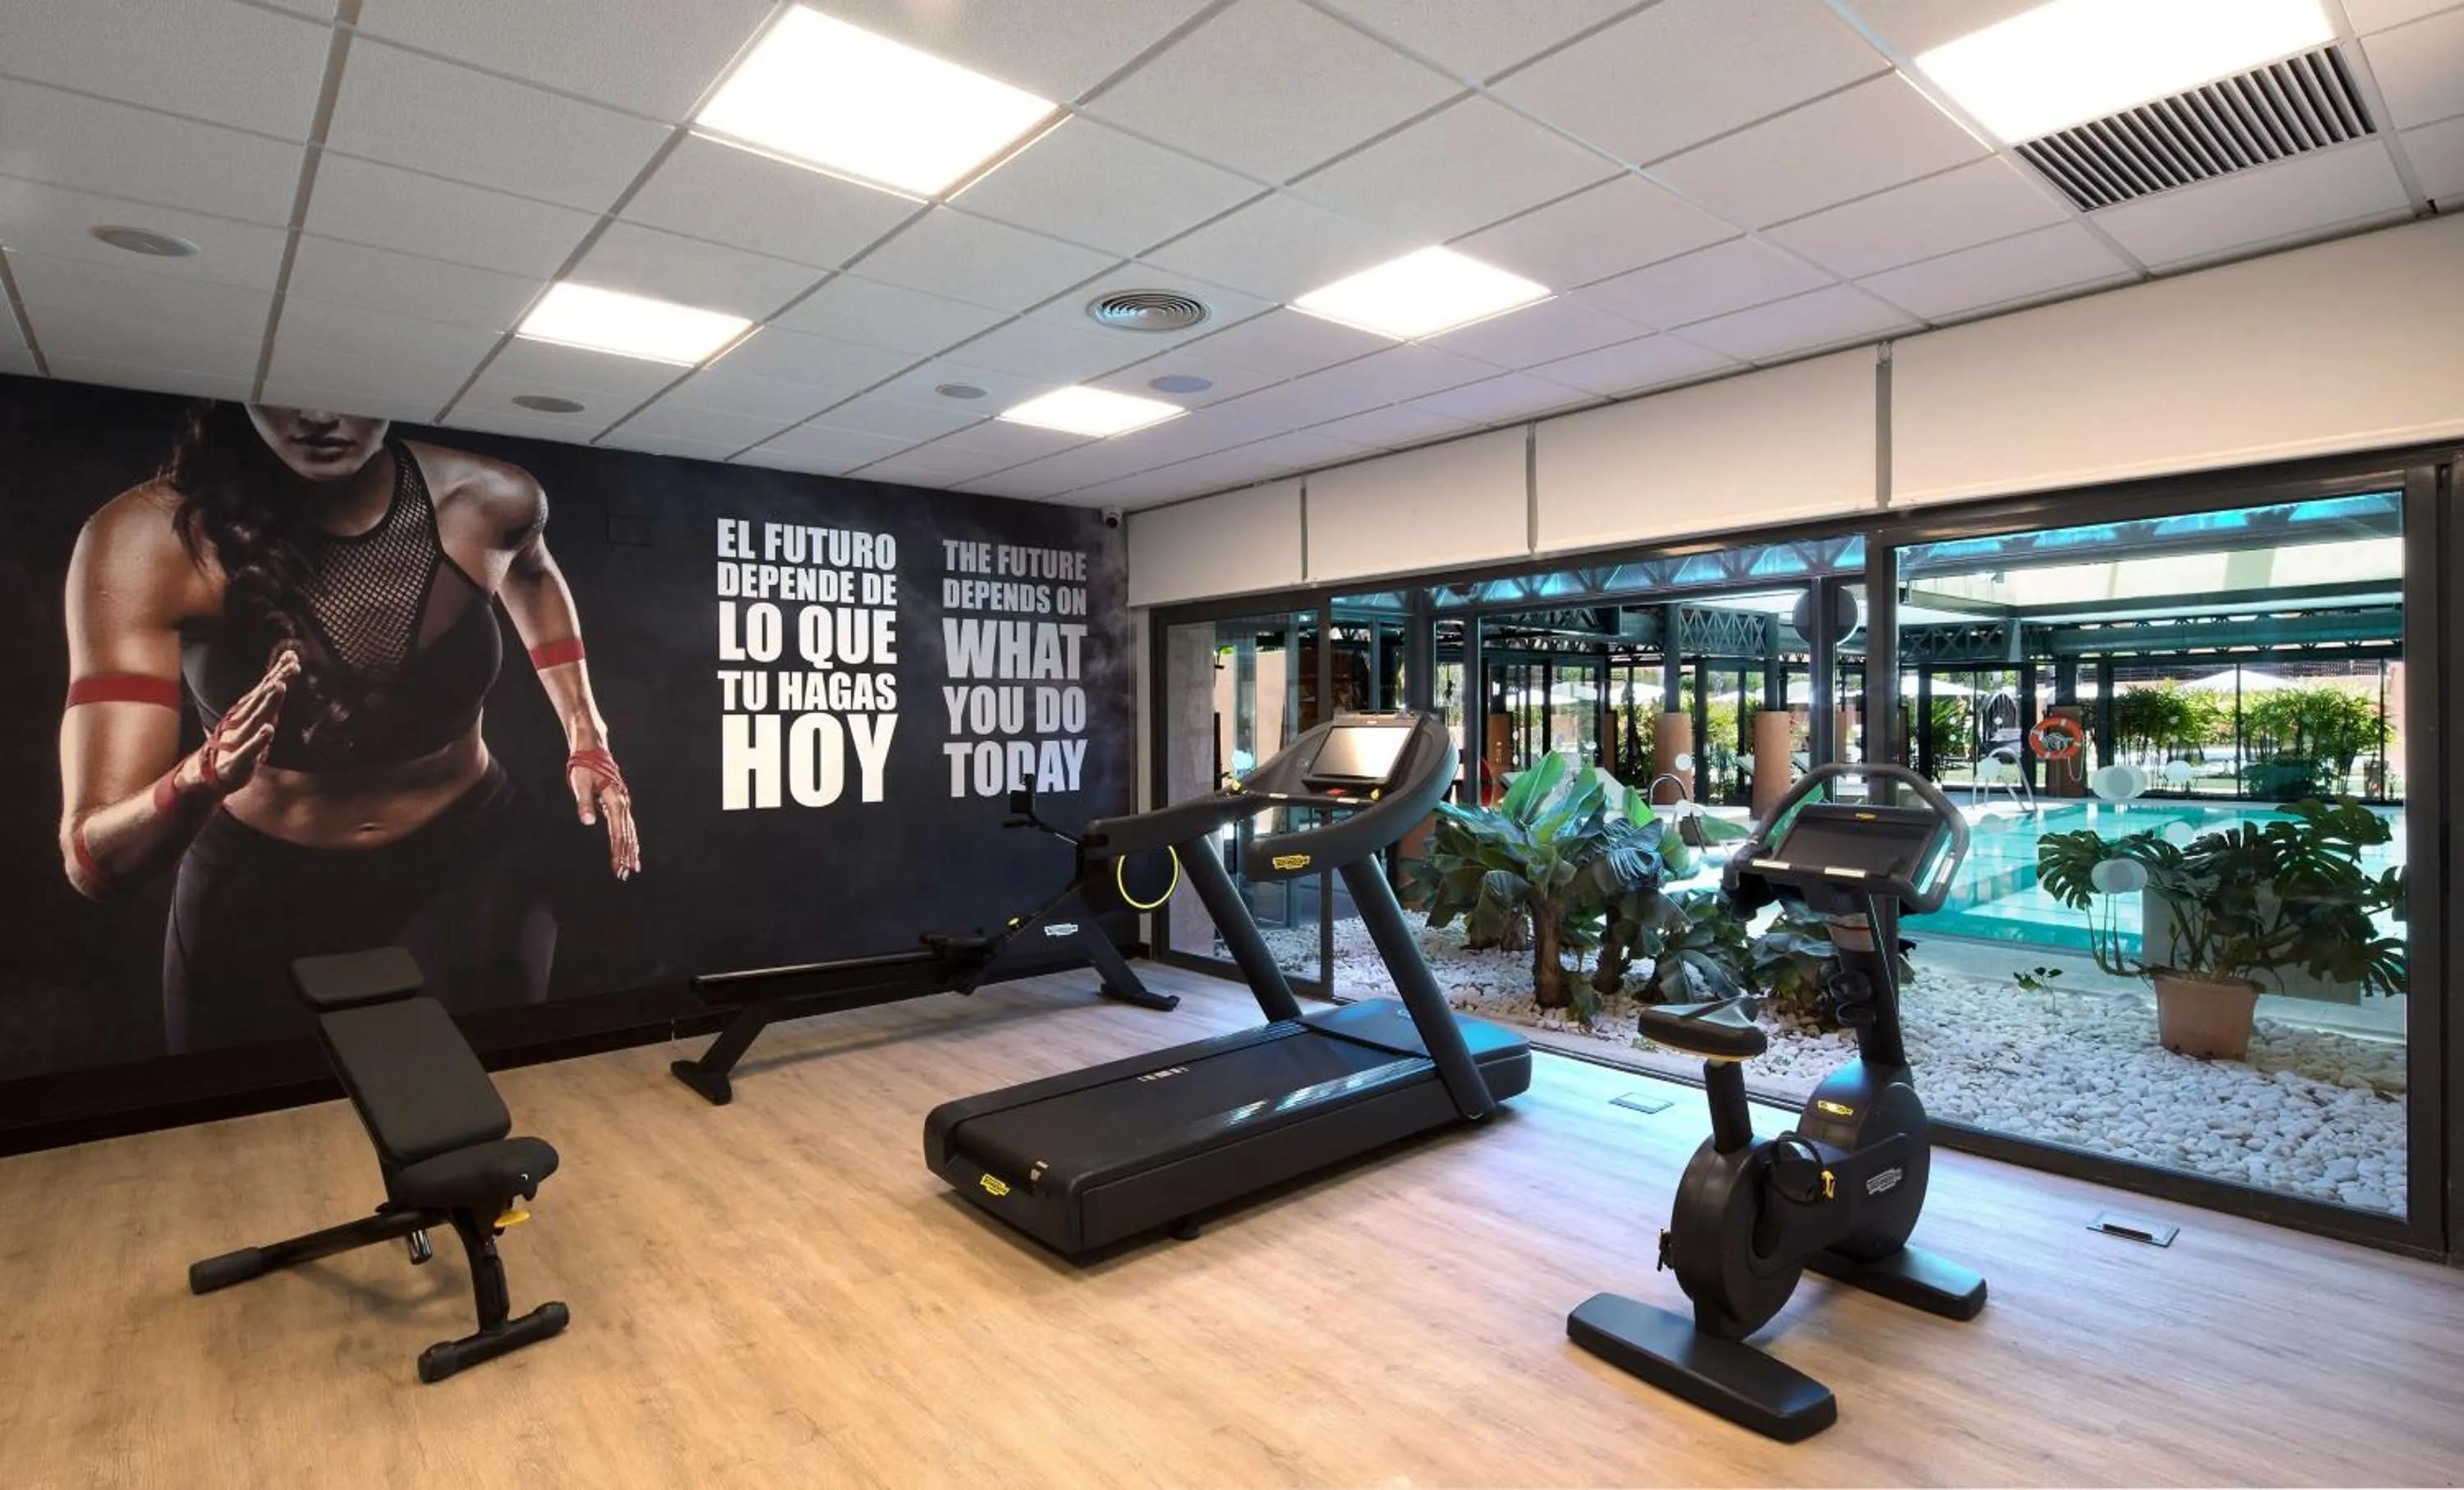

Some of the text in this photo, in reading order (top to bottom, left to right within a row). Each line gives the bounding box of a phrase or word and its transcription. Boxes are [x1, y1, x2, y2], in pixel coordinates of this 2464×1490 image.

[717, 517, 896, 571] EL FUTURO
[942, 539, 1087, 582] THE FUTURE
[717, 561, 898, 606] DEPENDE DE
[943, 577, 1087, 615] DEPENDS ON
[719, 600, 898, 669] LO QUE
[942, 617, 1087, 680] WHAT
[717, 669, 898, 712] TU HAGAS
[942, 685, 1087, 735] YOU DO
[722, 711, 899, 811] HOY
[943, 738, 1088, 798] TODAY
